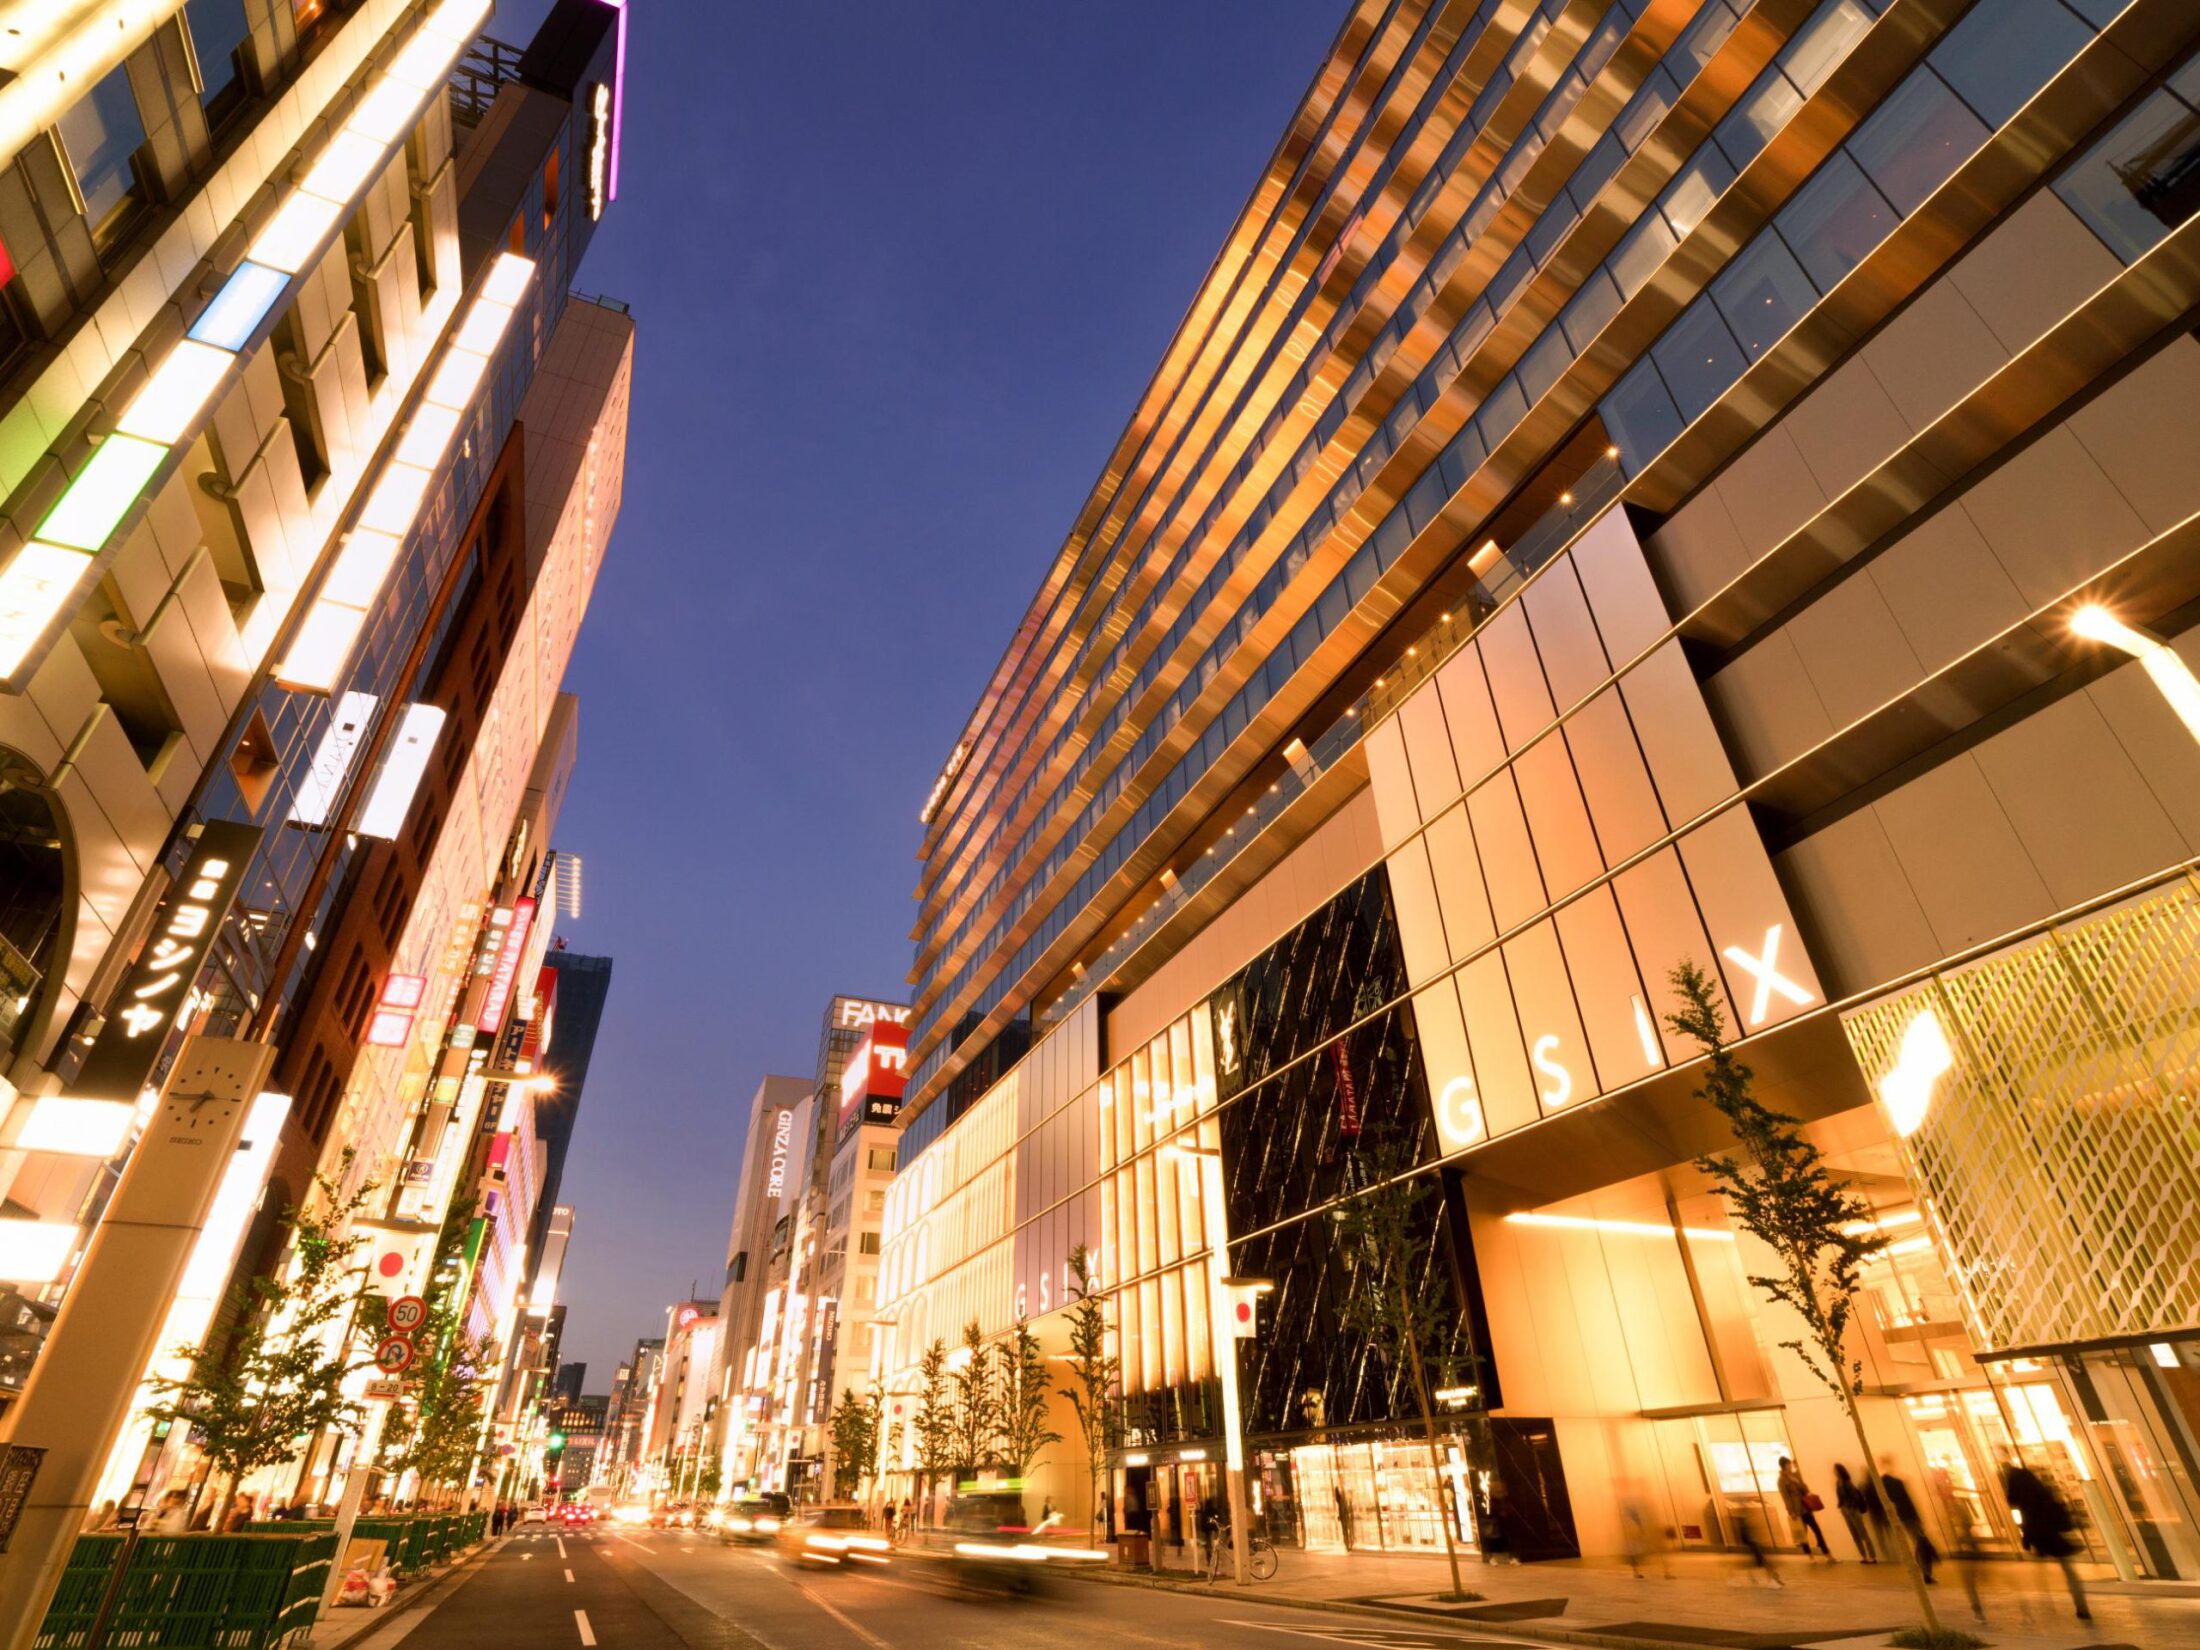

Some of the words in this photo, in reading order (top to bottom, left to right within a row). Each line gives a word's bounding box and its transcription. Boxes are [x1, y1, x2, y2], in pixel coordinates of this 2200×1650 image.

[169, 1136, 203, 1145] SEIKO
[776, 1110, 793, 1154] GINZA
[768, 1154, 787, 1198] CORE
[396, 1305, 418, 1322] 50
